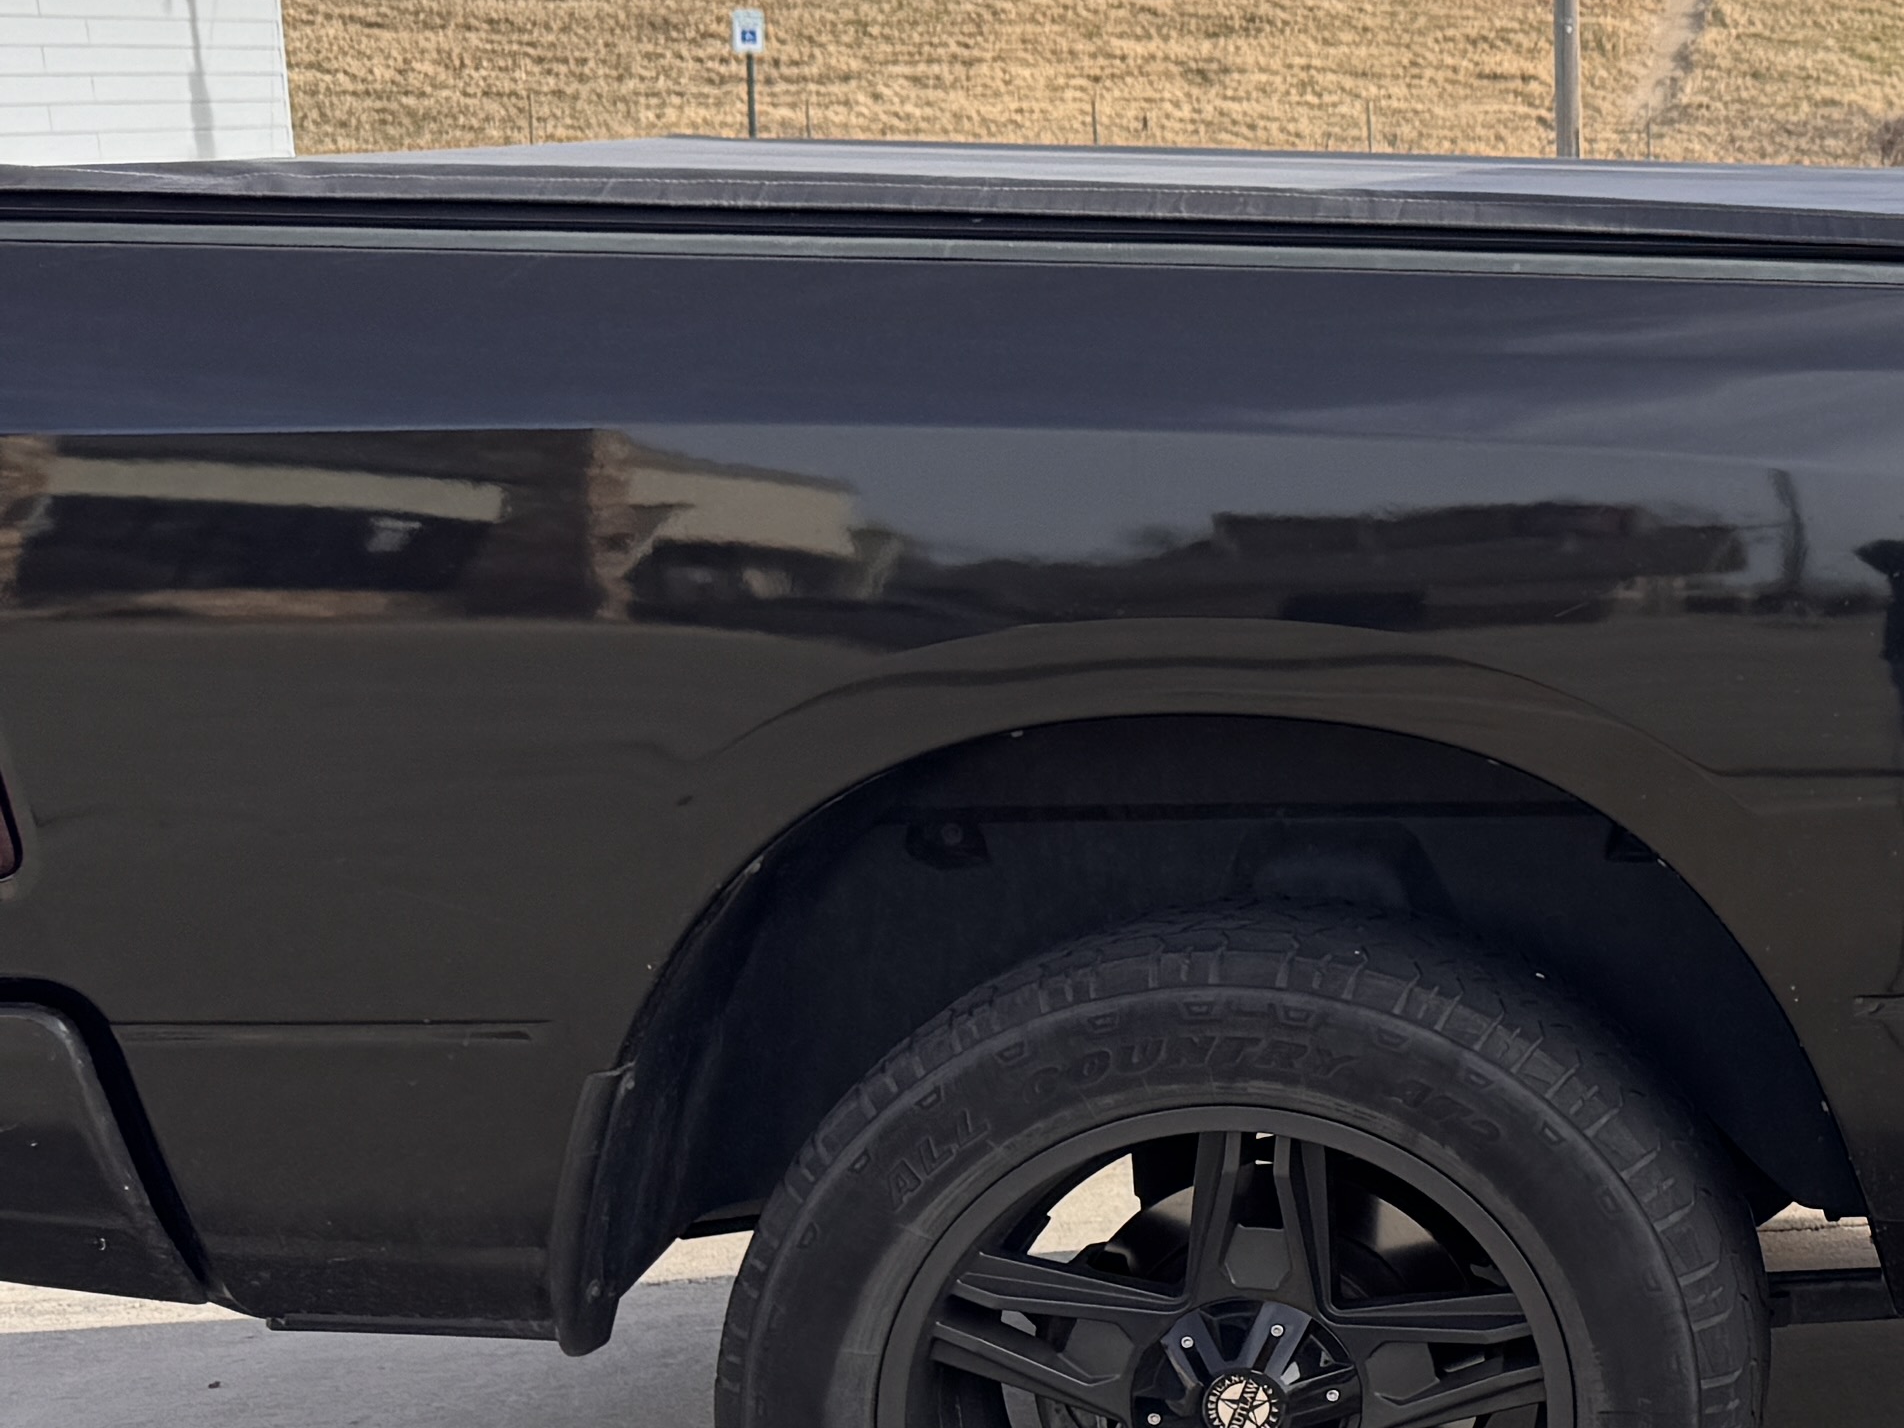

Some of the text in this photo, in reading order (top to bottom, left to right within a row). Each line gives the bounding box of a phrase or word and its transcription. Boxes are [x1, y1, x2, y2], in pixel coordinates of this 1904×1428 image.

[886, 1110, 994, 1210] ALL
[1023, 1033, 1359, 1107] COUNTRY
[1207, 1375, 1240, 1426] AMERICAN
